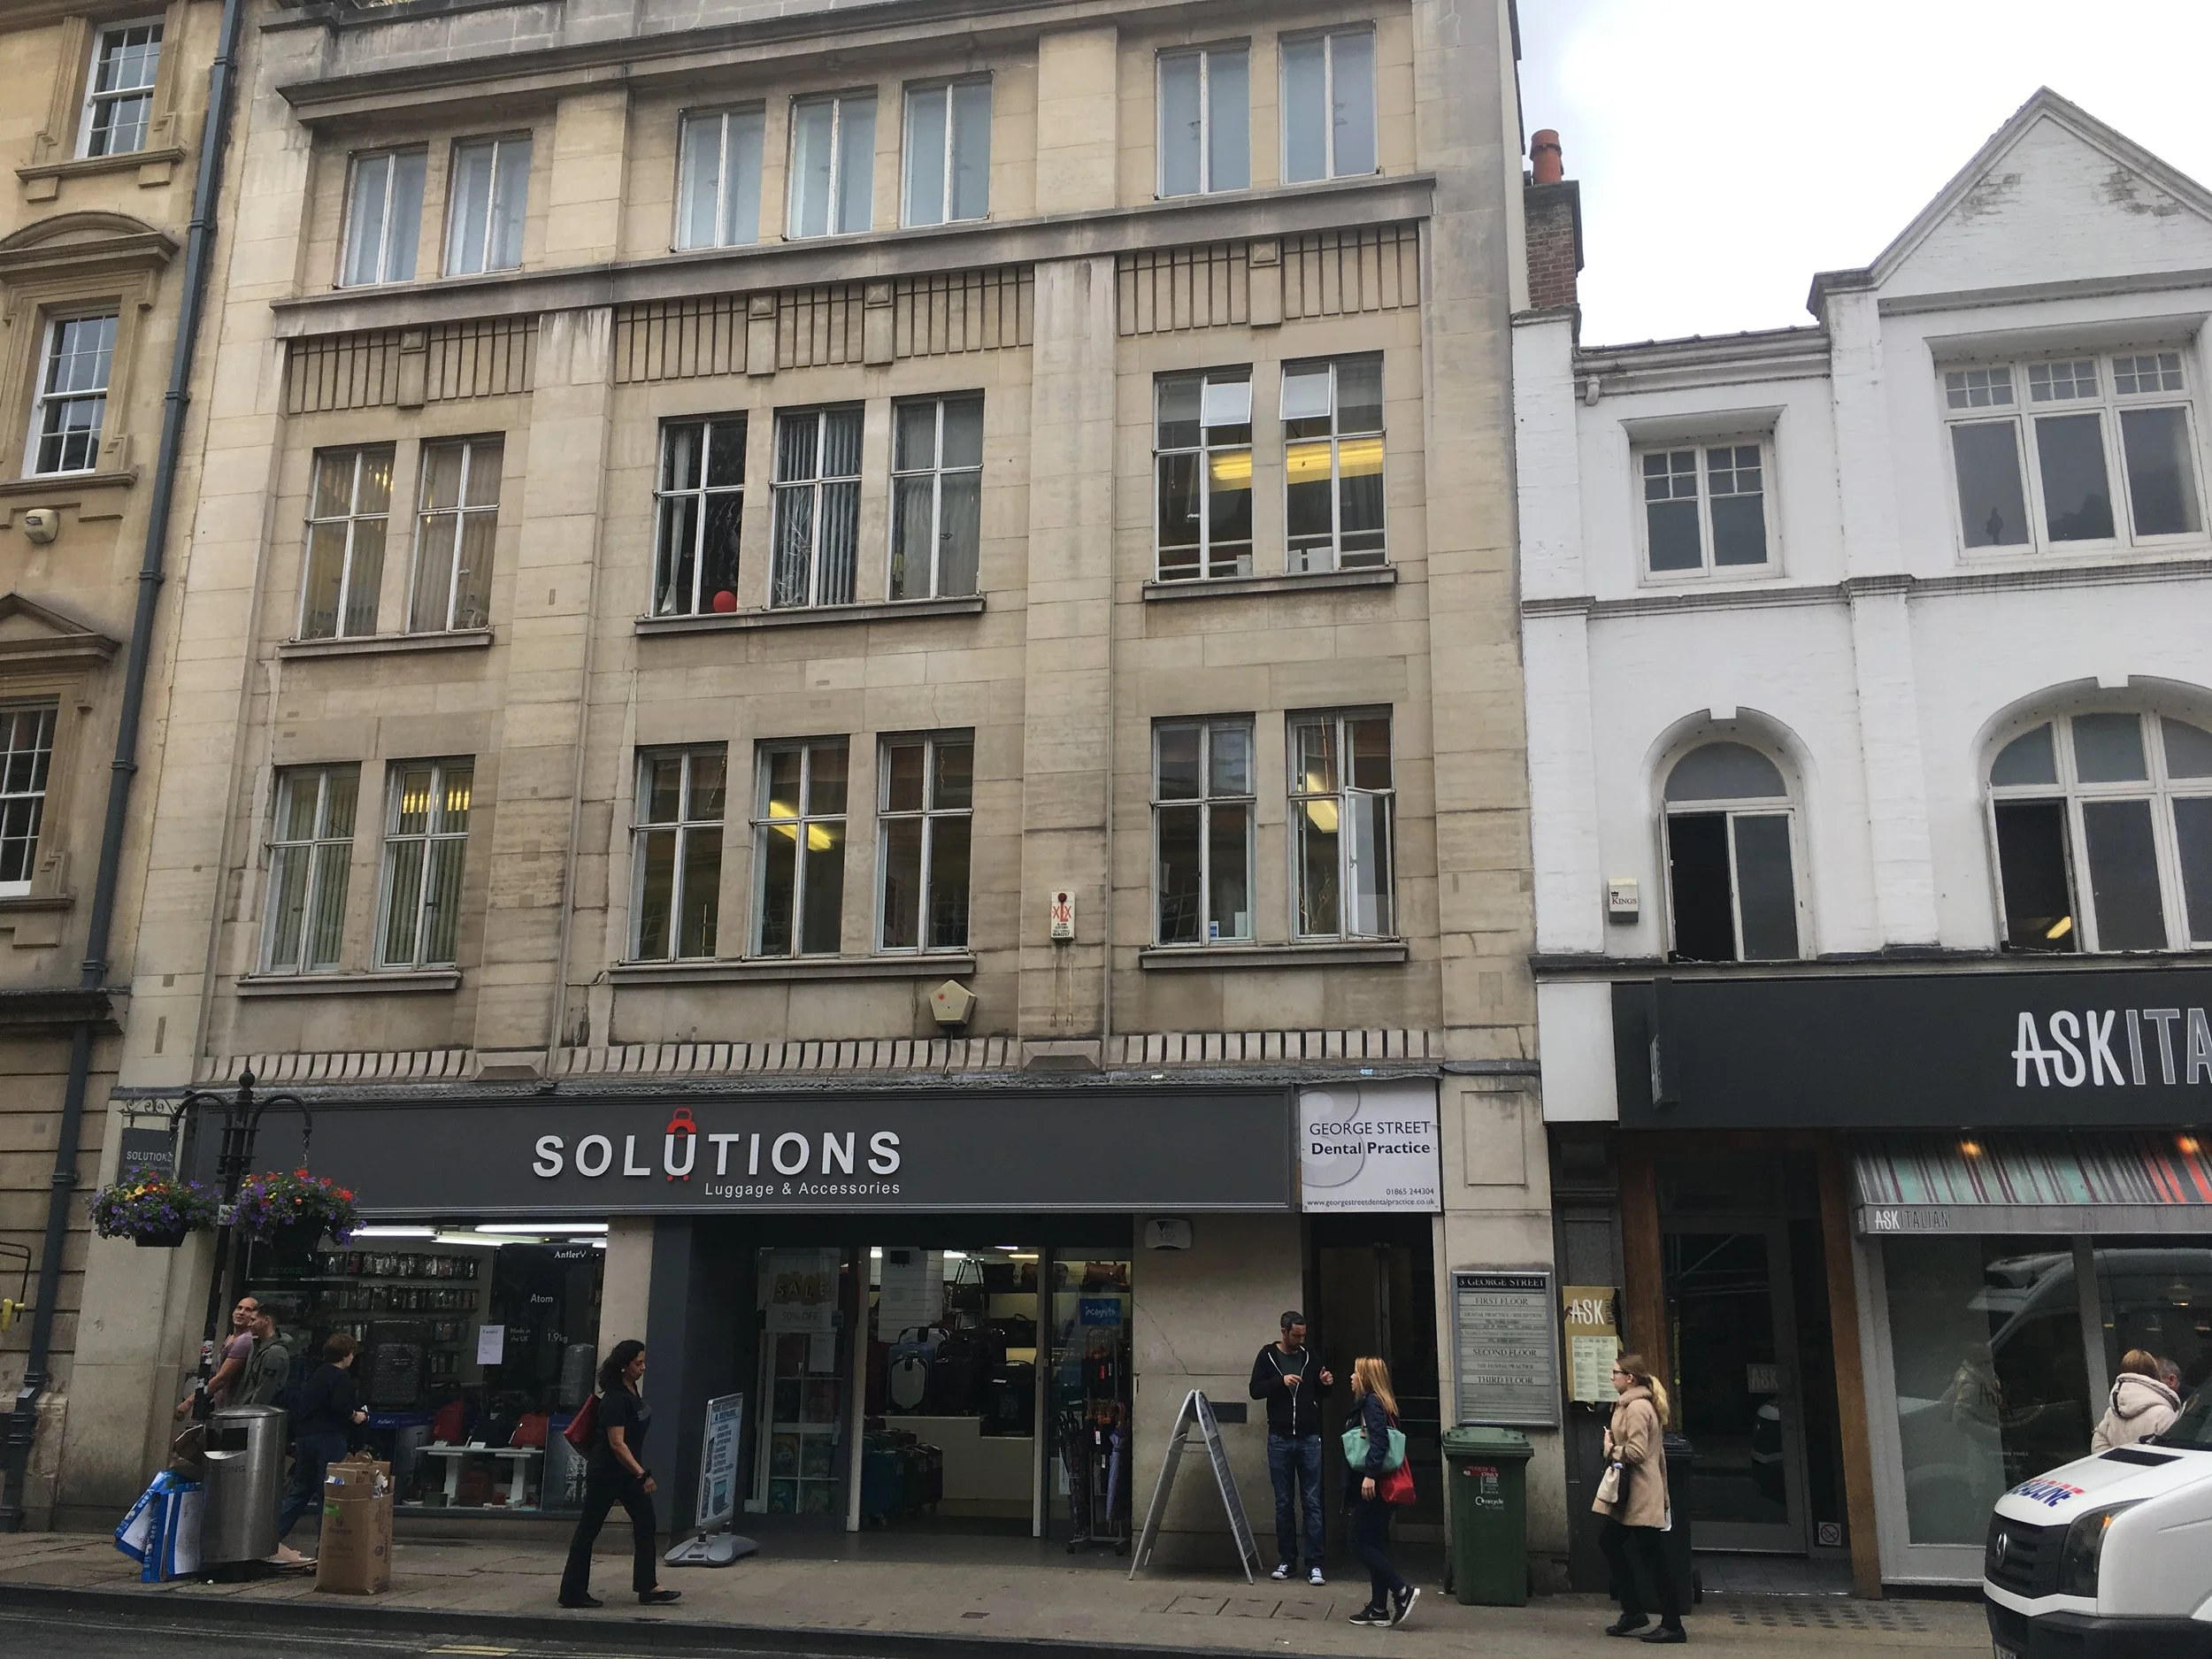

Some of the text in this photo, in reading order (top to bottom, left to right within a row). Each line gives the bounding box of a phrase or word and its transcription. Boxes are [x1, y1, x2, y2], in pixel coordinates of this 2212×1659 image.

[1310, 1121, 1431, 1135] GEORGE STREET
[533, 1131, 901, 1179] SOLUTIONS
[1311, 1141, 1431, 1156] Dental Practice
[705, 1180, 901, 1198] Luggage & Accessories
[1307, 1198, 1434, 1208] www.georgestreetdentalpractice.co.uk
[1459, 1278, 1464, 1286] 3
[1509, 1279, 1544, 1287] STREET
[779, 1282, 830, 1299] SALE
[530, 1293, 554, 1303] Atom
[801, 1311, 818, 1321] OFF
[1085, 1306, 1117, 1318] incognito
[1570, 1299, 1605, 1325] ASK
[547, 1333, 568, 1344] 1.9kg
